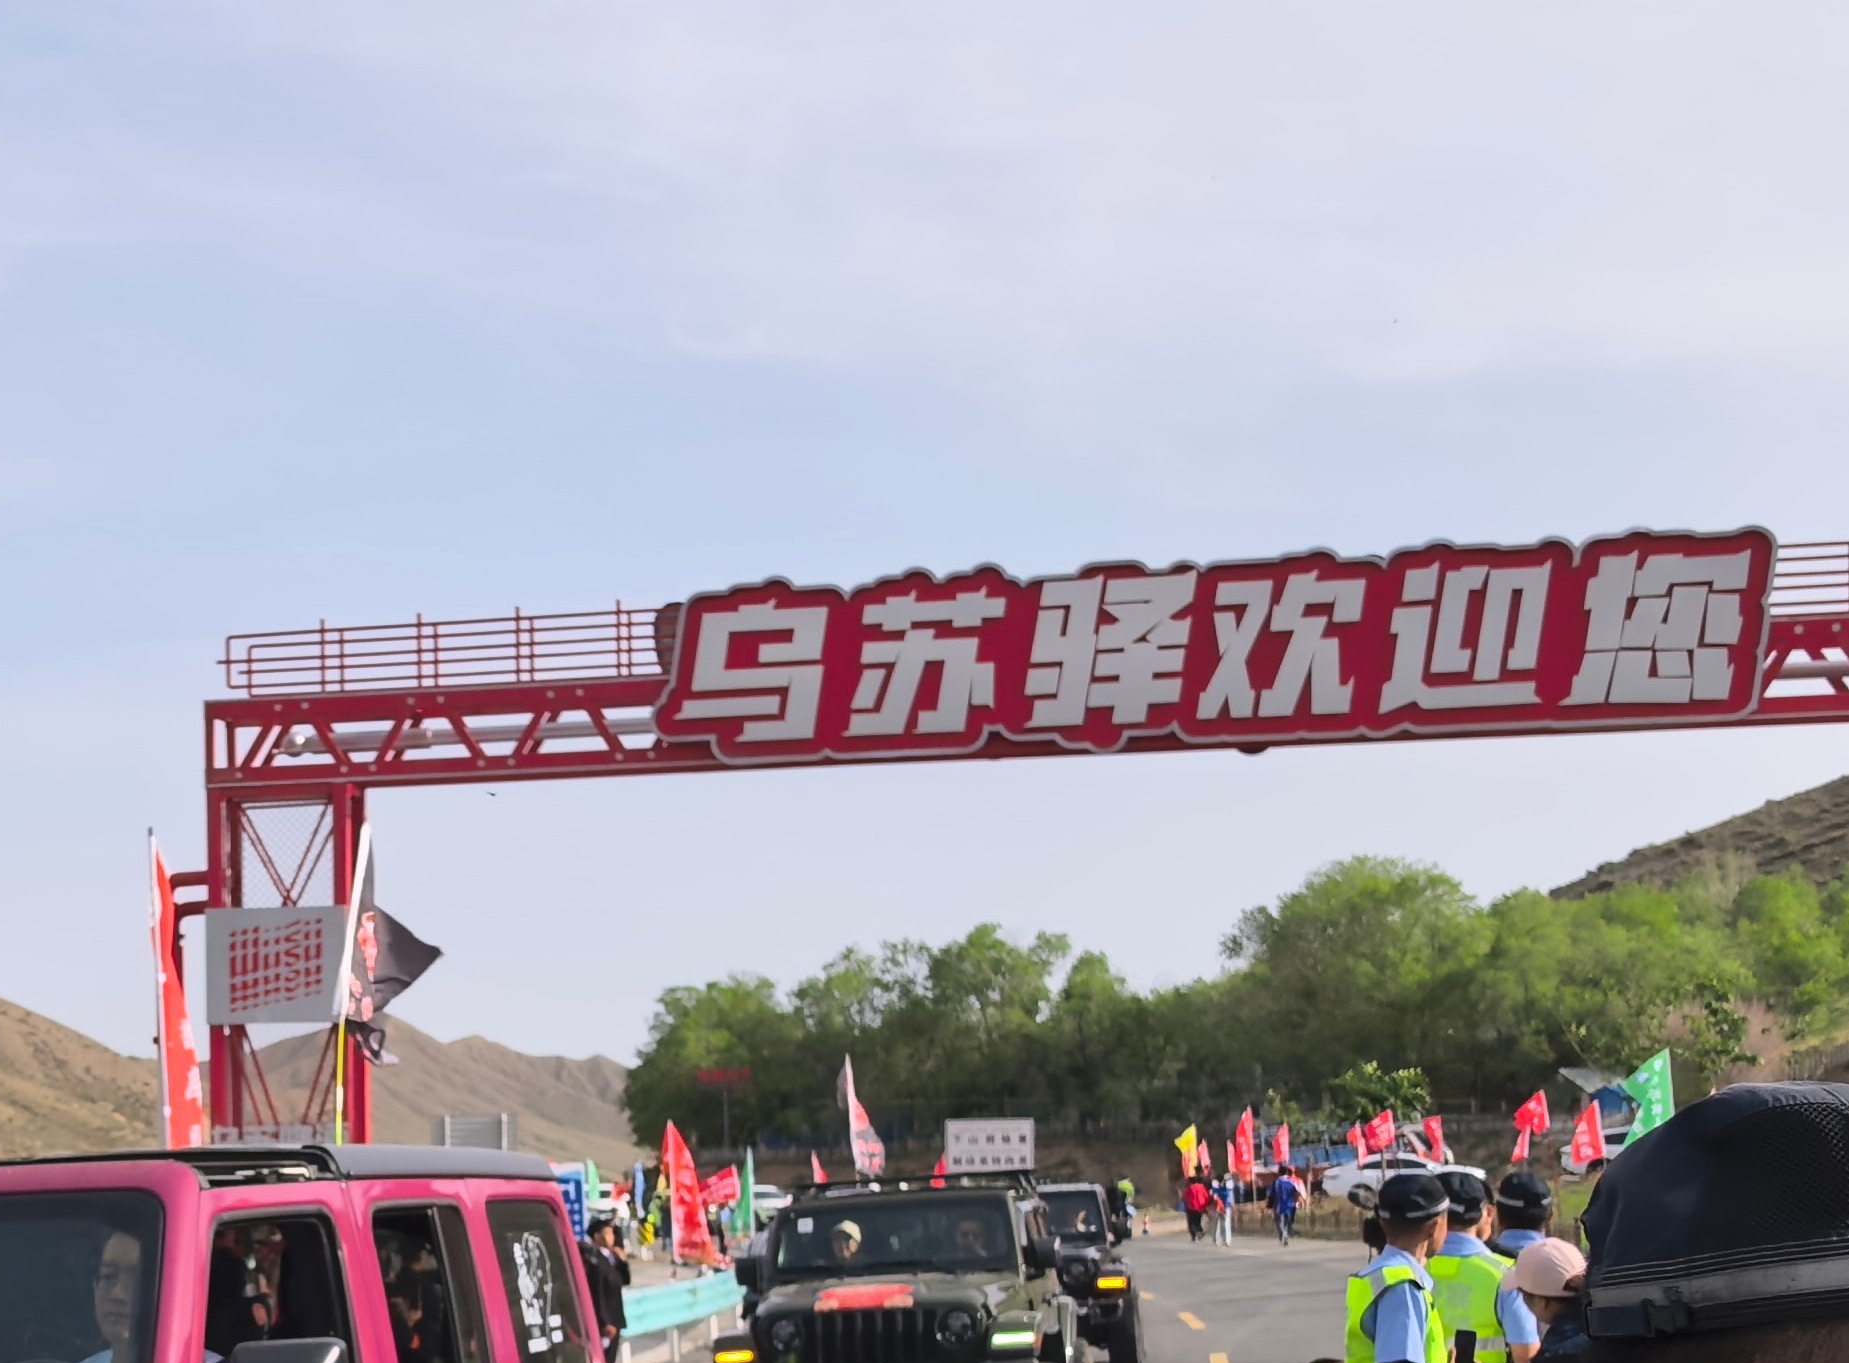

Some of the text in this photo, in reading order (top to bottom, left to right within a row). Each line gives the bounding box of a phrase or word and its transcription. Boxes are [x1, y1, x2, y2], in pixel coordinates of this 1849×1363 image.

[677, 547, 1752, 745] 乌苏驿欢迎您
